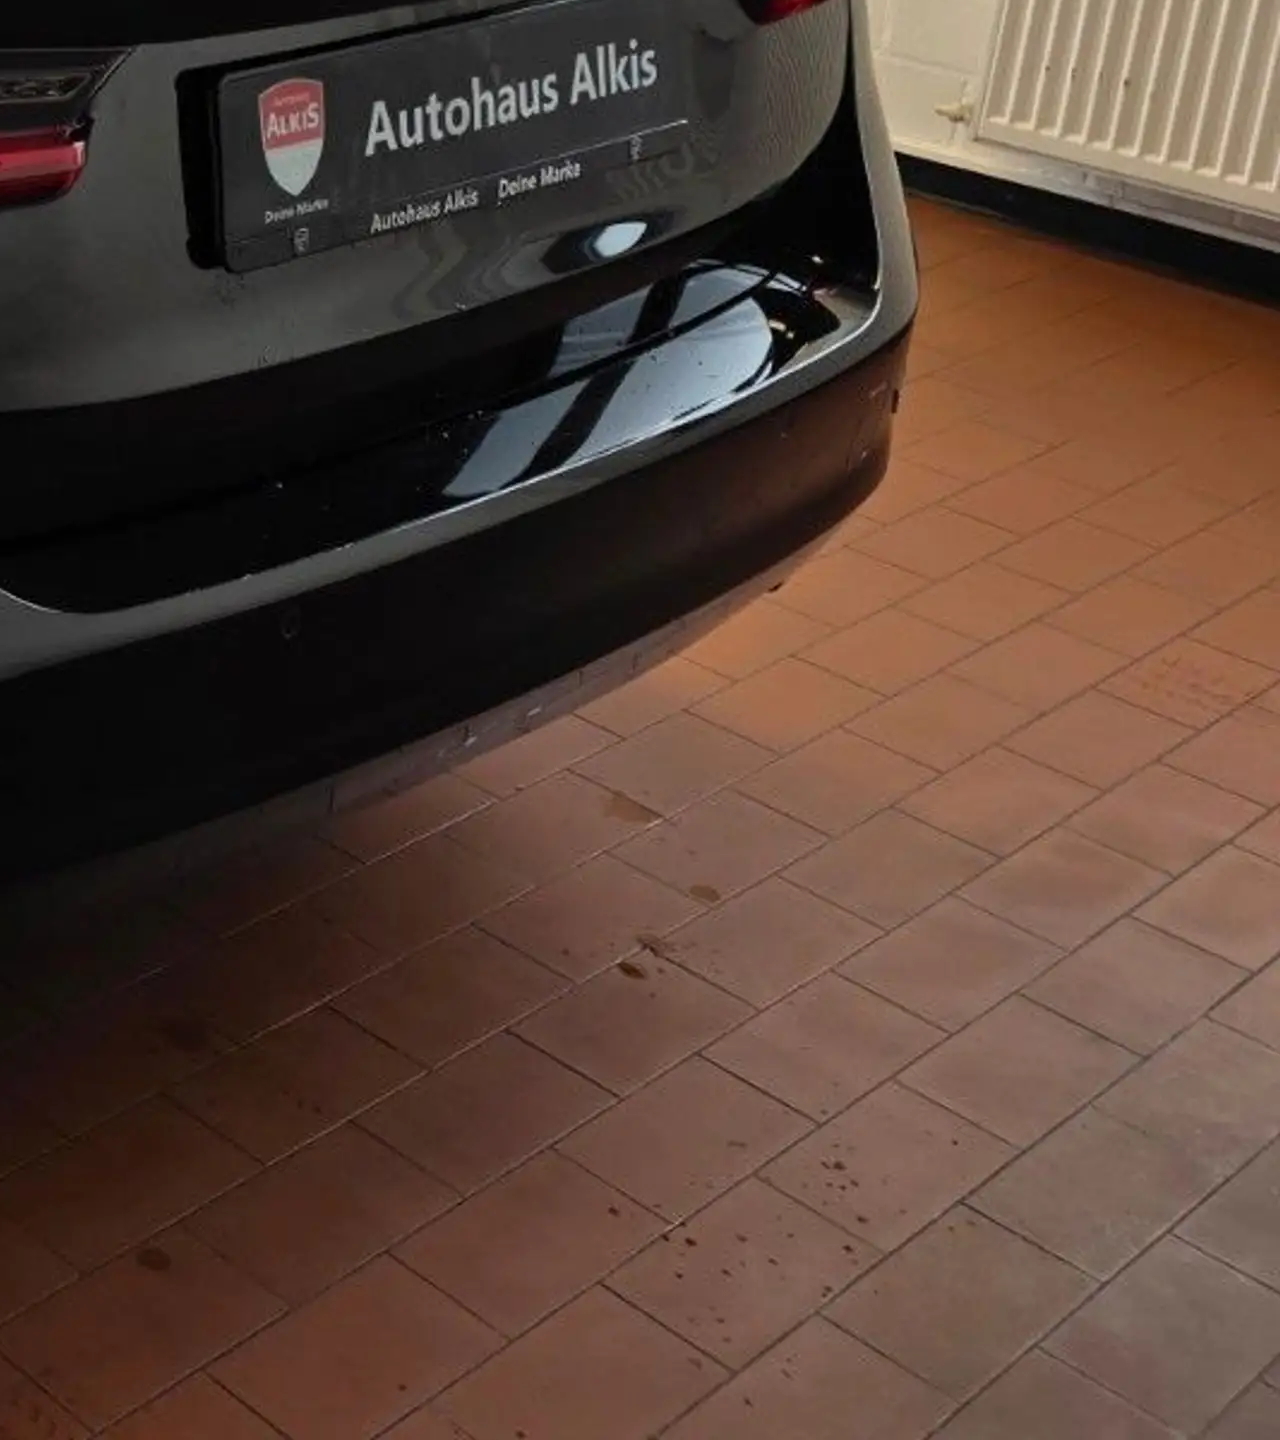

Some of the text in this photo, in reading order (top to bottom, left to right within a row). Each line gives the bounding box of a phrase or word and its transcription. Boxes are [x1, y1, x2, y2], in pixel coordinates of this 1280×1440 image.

[364, 38, 659, 158] Autohaus Alkis
[370, 160, 582, 235] Autohaus Alkis Deine Marke
